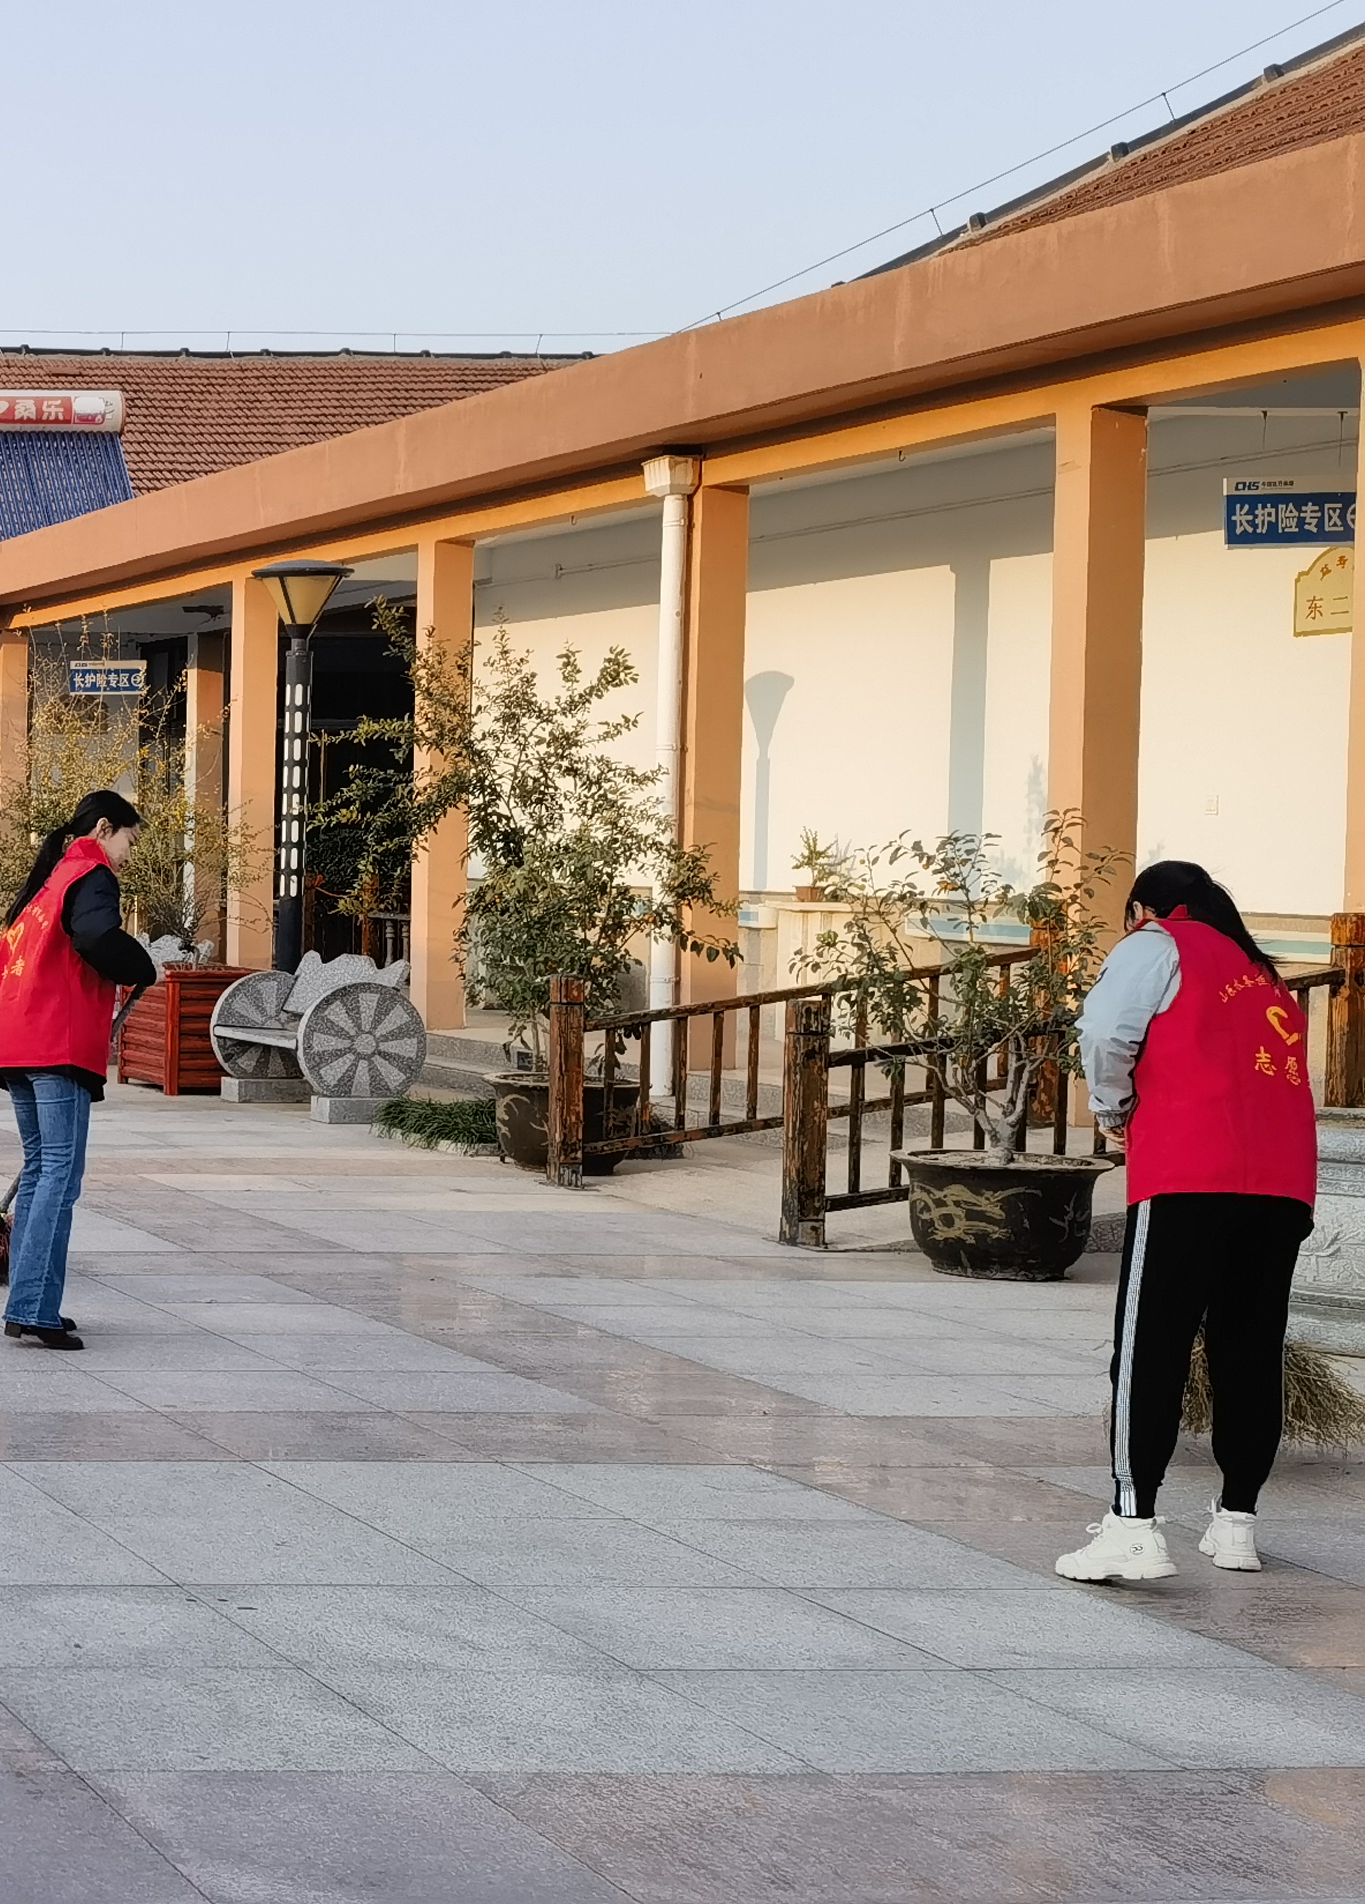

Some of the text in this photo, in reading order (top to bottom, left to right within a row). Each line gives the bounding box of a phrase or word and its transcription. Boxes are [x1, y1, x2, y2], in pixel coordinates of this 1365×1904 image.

[13, 399, 65, 421] 桑乐
[1231, 502, 1344, 535] 长护险专区
[73, 667, 129, 689] 长护险专区
[1254, 1045, 1302, 1086] 志愿
